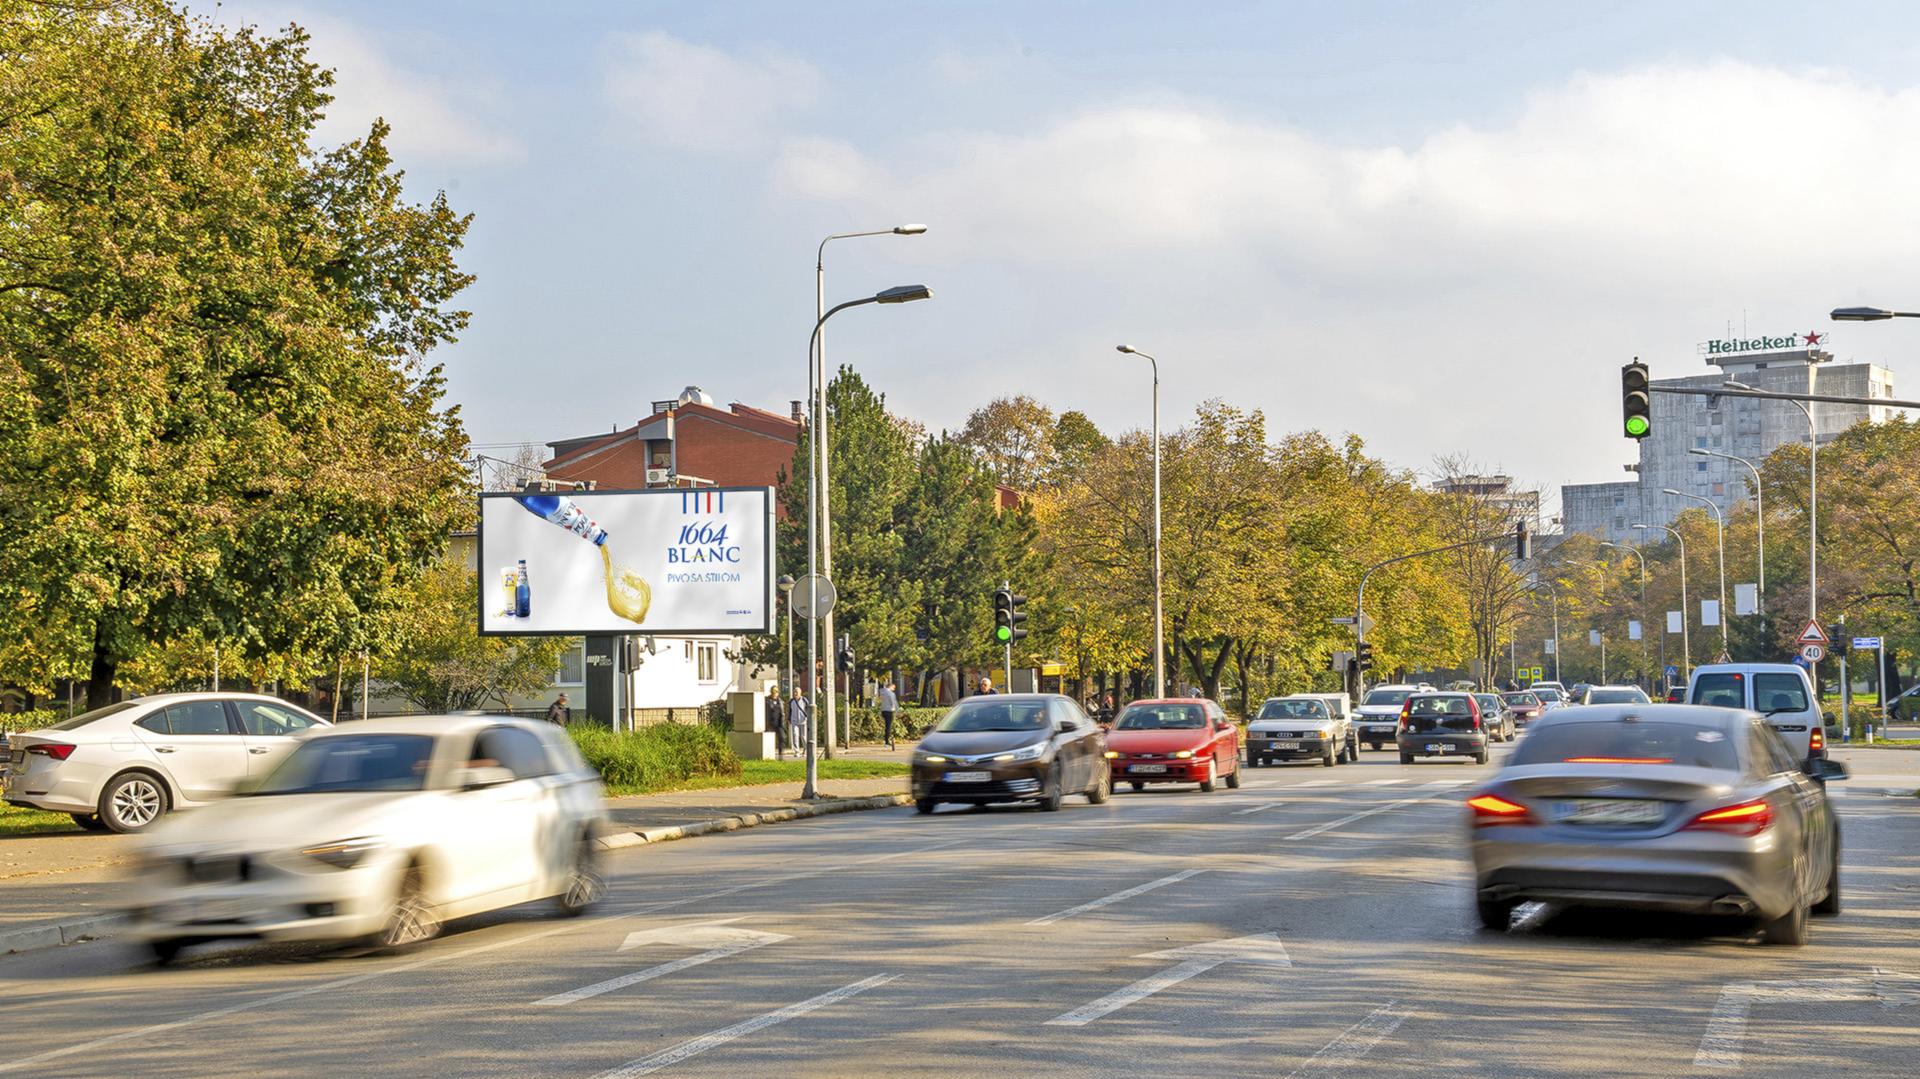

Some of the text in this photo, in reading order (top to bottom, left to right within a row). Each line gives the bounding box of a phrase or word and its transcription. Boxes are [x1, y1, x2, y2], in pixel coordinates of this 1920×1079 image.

[1708, 336, 1797, 354] Heineken
[678, 521, 729, 546] 1664
[667, 546, 741, 563] BLANC
[667, 573, 690, 583] PIVO
[690, 573, 703, 583] SA
[1805, 647, 1820, 658] 40
